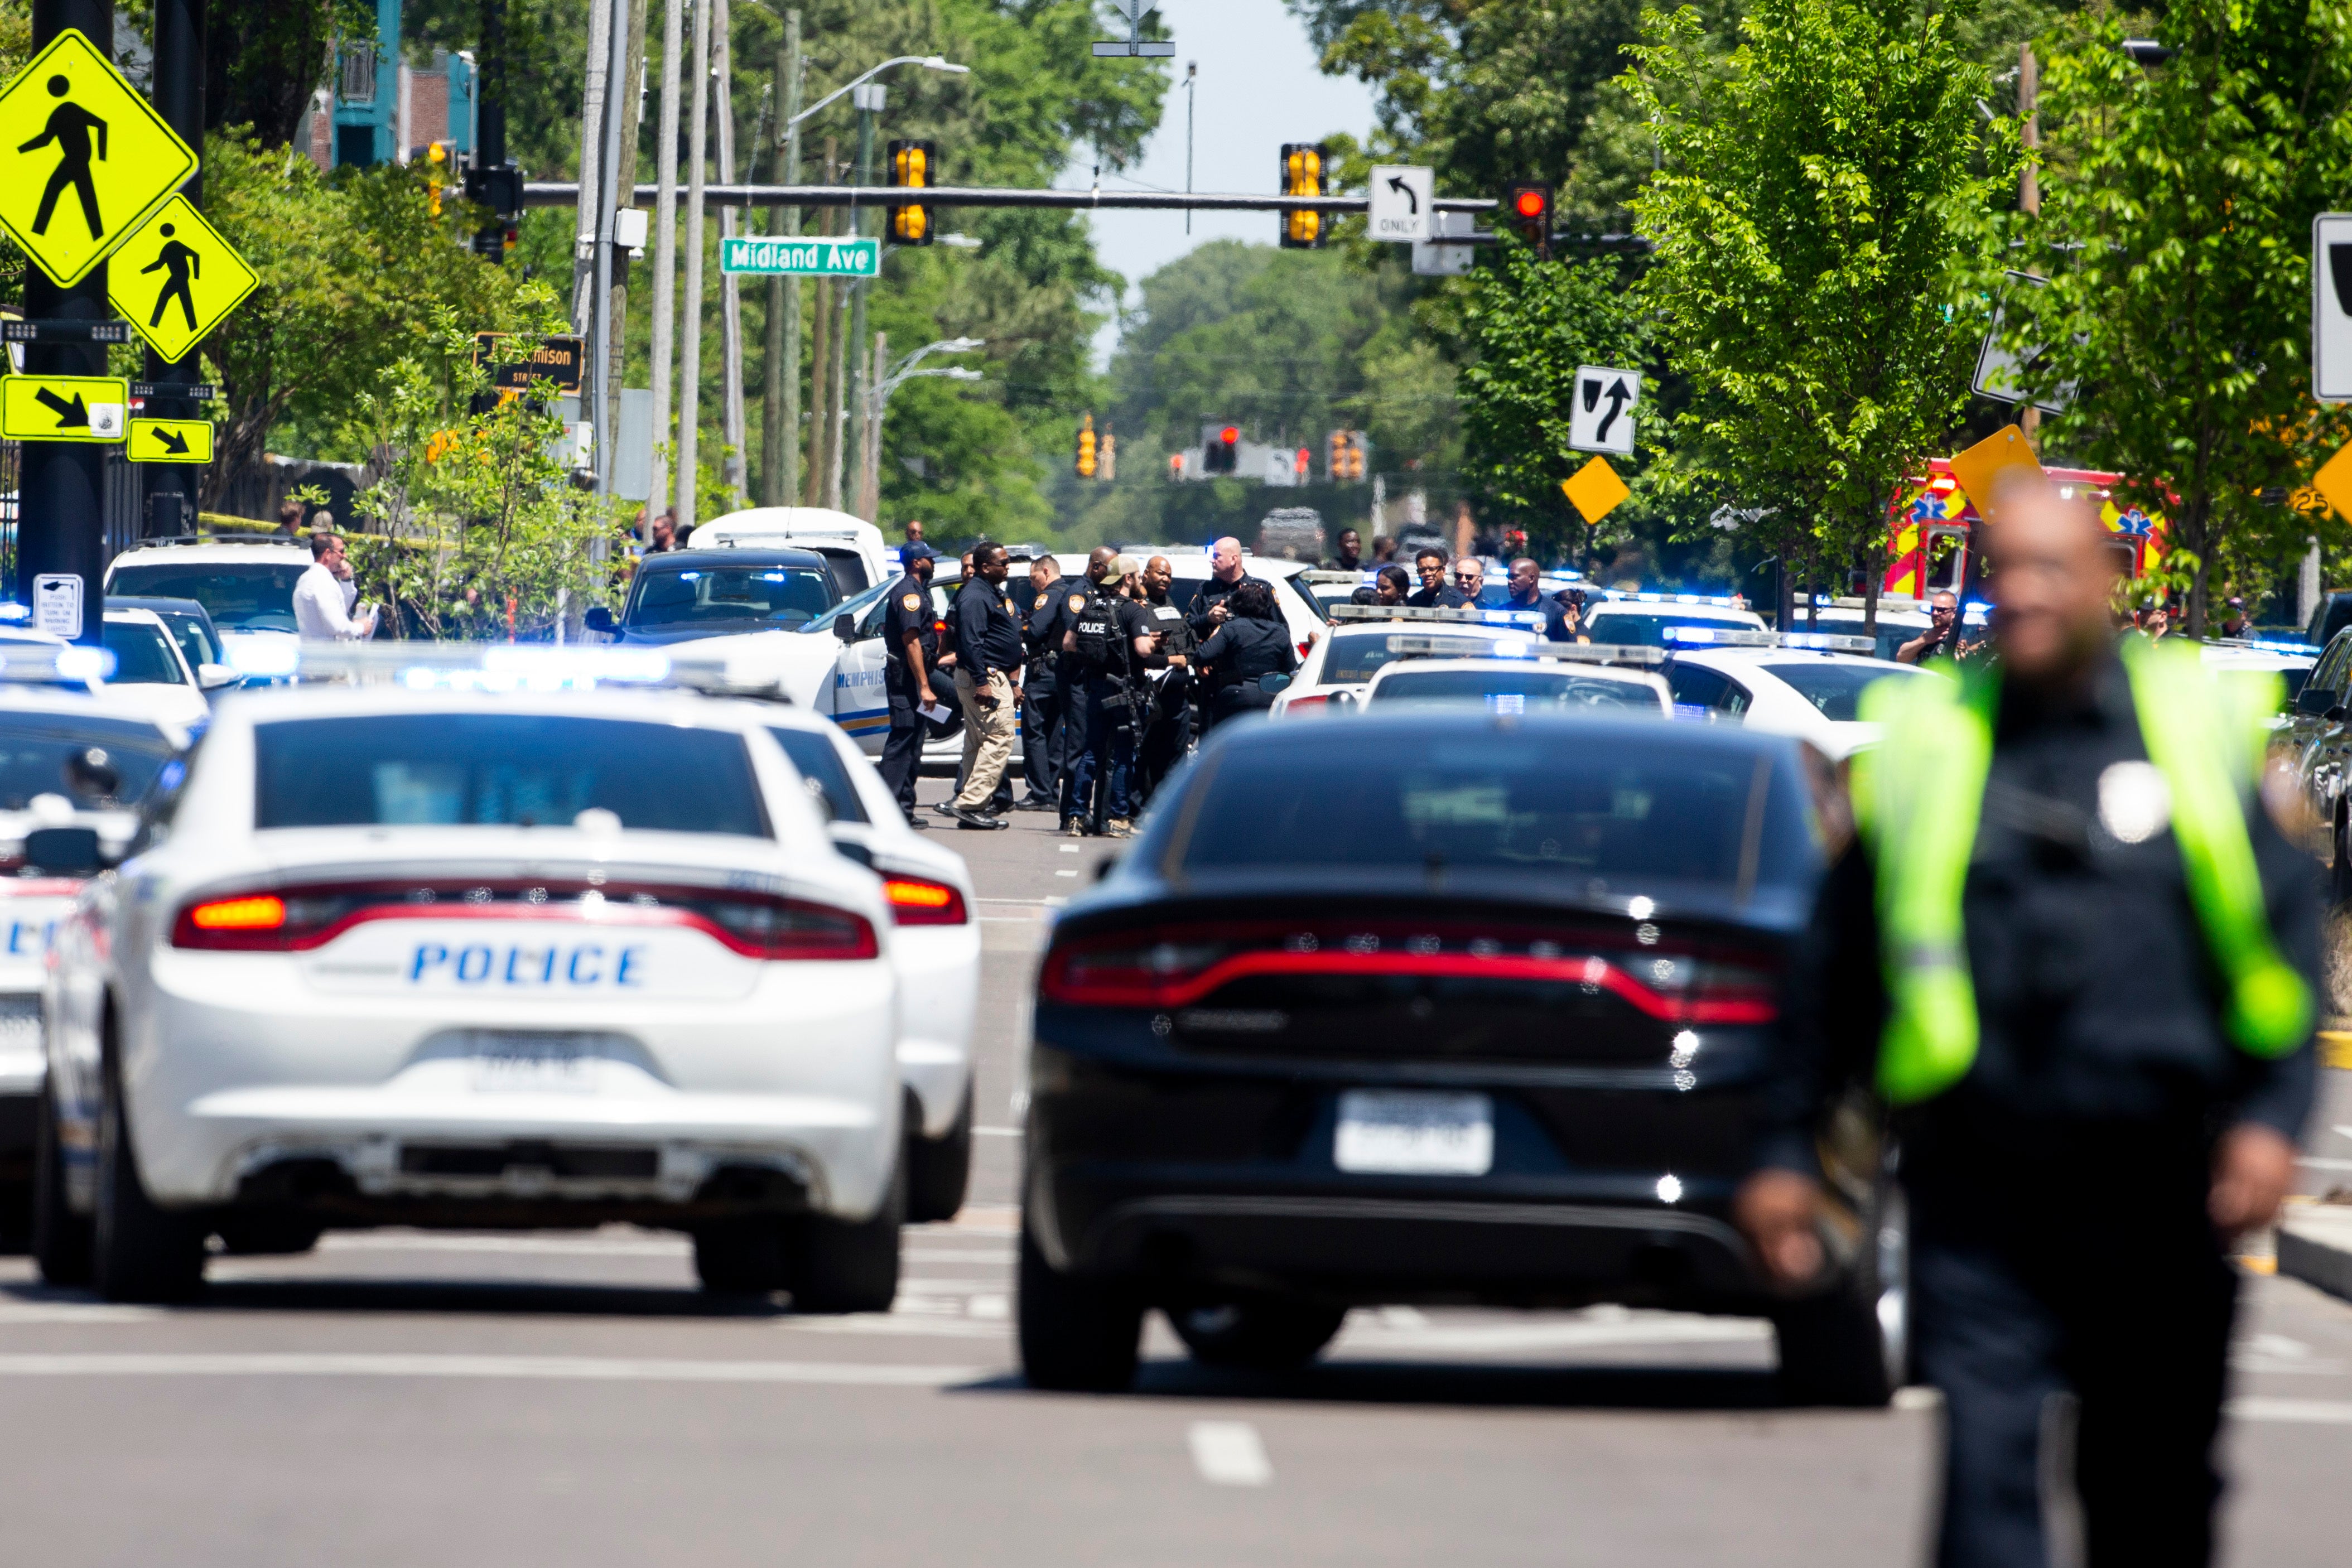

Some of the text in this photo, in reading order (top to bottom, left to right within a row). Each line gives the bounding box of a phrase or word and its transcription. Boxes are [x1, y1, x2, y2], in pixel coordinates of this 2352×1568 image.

[1379, 218, 1420, 233] ONLY
[731, 243, 869, 272] Midland Ave
[2296, 492, 2329, 513] 25
[1078, 621, 1106, 634] POLICE
[837, 670, 885, 688] MEMPHIS
[411, 943, 646, 985] POLICE
